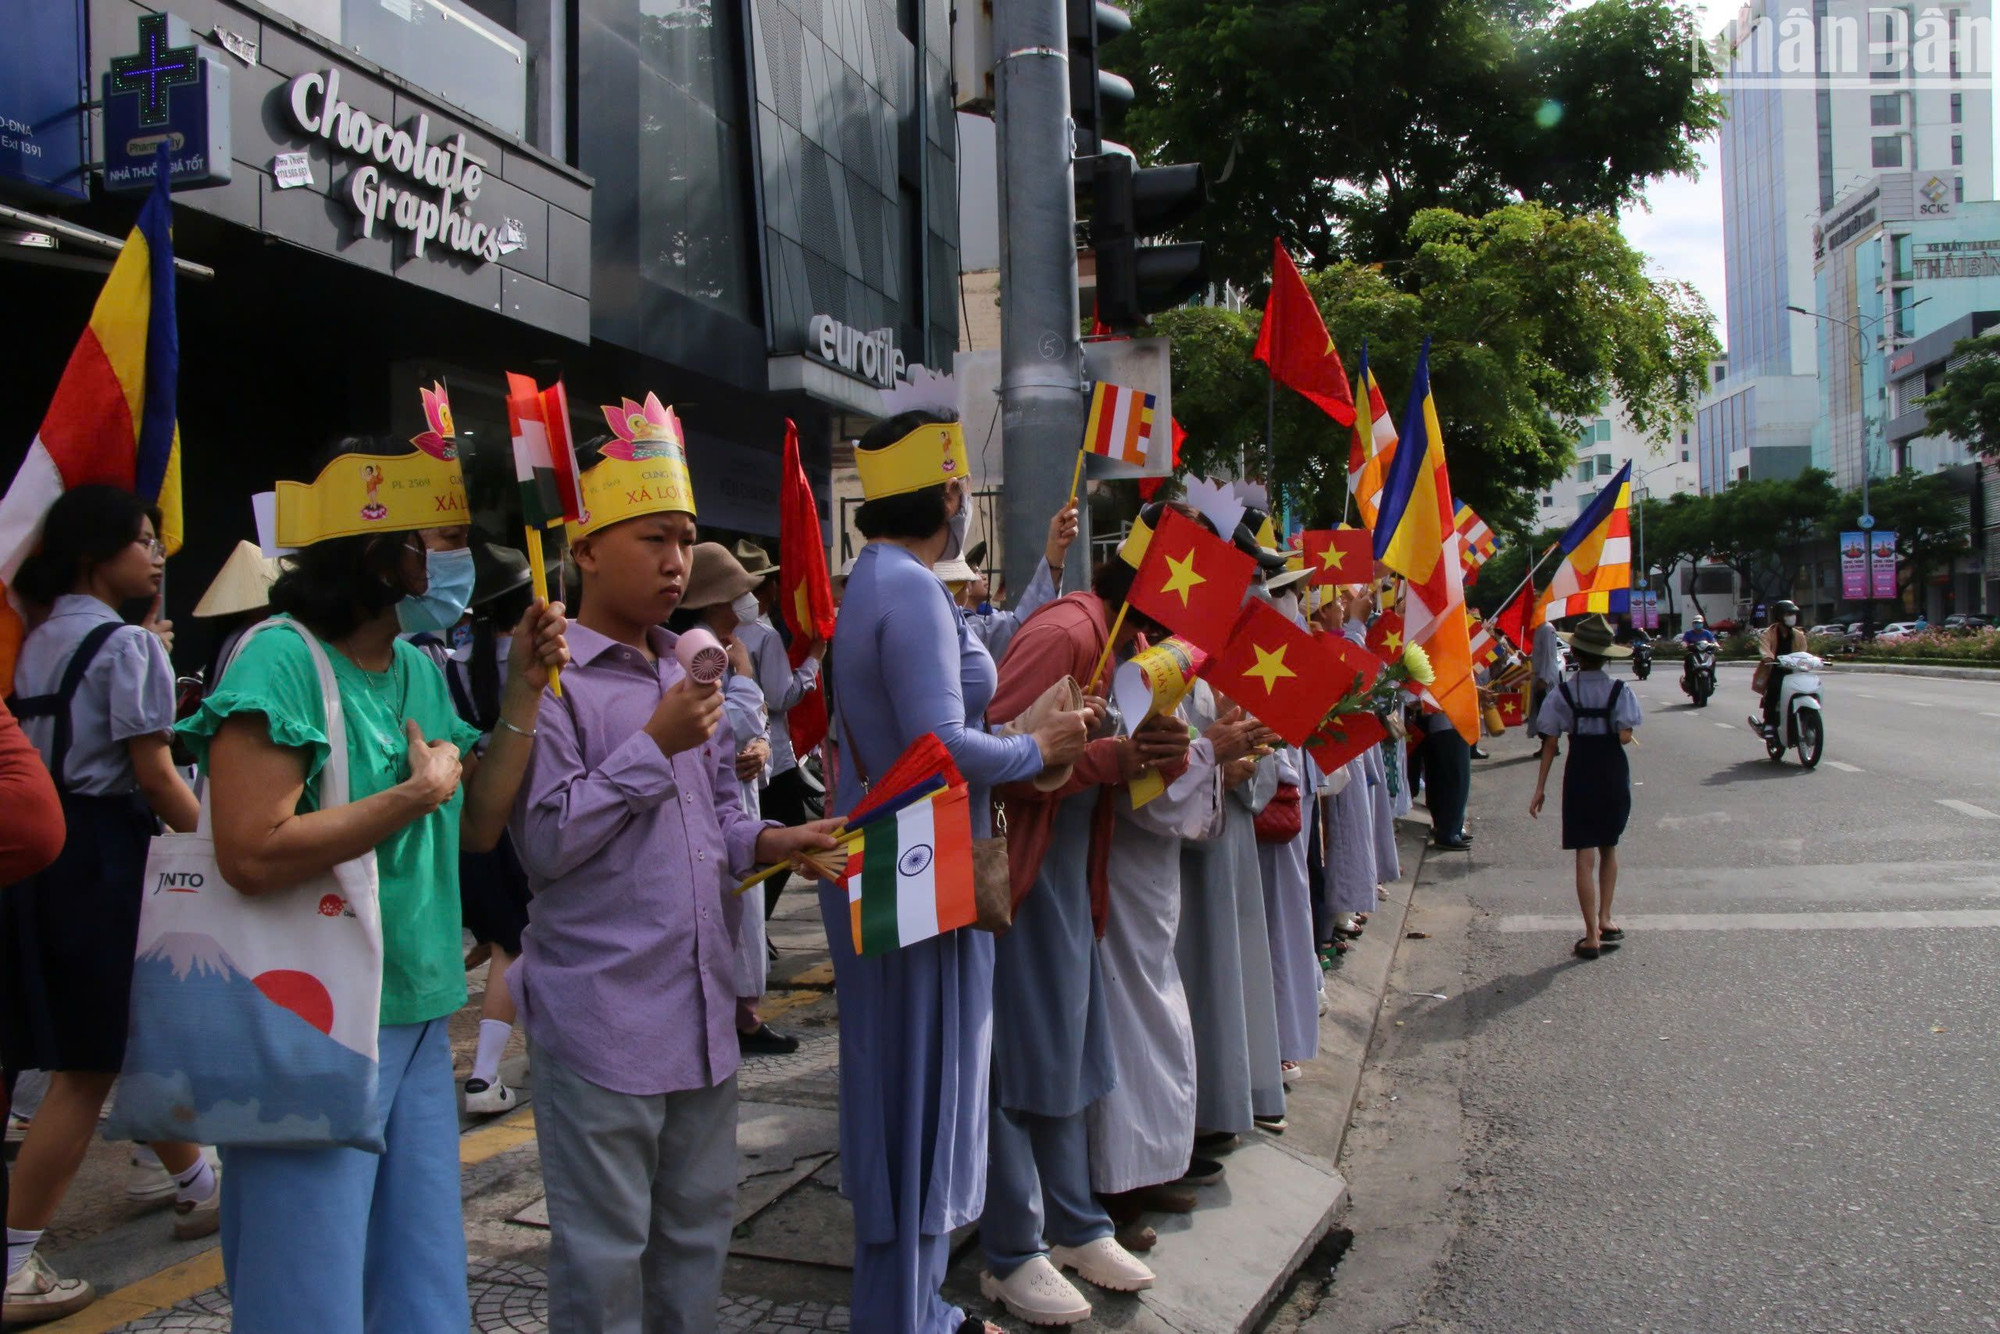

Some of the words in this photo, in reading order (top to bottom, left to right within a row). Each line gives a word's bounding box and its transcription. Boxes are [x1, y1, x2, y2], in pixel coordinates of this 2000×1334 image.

[292, 68, 488, 201] Chocolate
[21, 142, 42, 158] 1391
[186, 154, 204, 170] TỐT
[352, 166, 499, 262] Graphics
[1920, 203, 1950, 215] SCIC
[809, 314, 906, 389] eurotile
[1044, 338, 1056, 358] 5
[435, 492, 458, 512] XÁ
[626, 485, 653, 505] XÁ
[153, 872, 204, 896] JNTO
